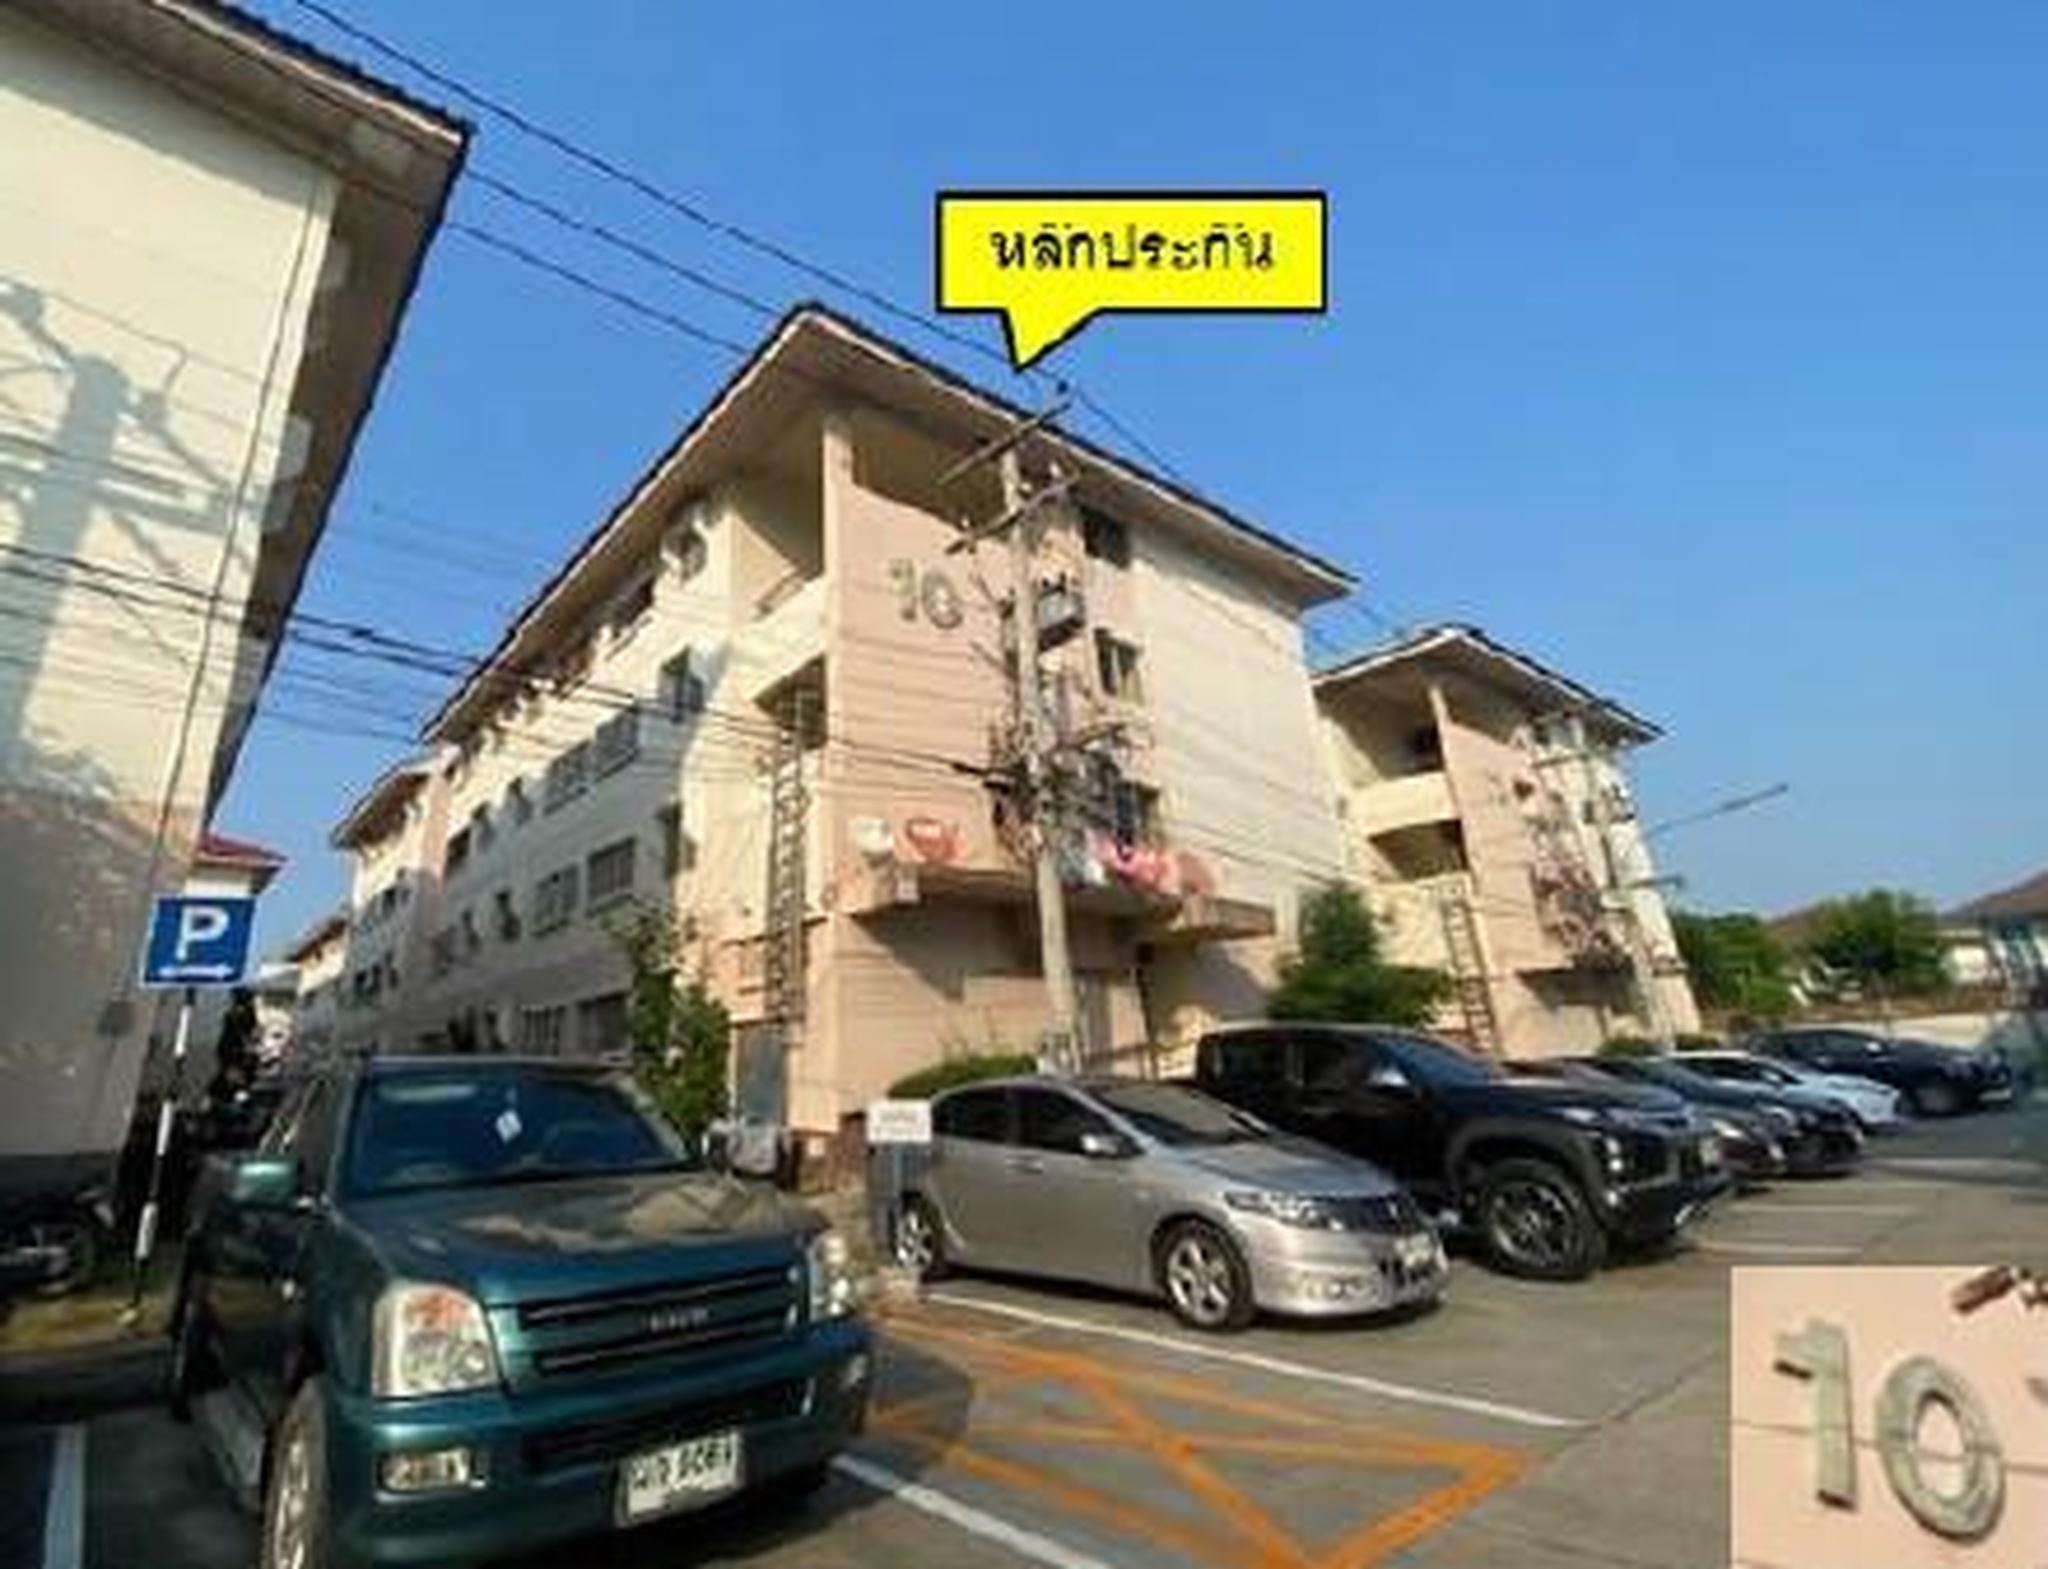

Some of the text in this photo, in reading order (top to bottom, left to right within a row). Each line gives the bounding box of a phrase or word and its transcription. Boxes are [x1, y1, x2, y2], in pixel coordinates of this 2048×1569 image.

[888, 558, 964, 630] 10
[176, 905, 229, 960] P
[1773, 1318, 2006, 1546] 10
